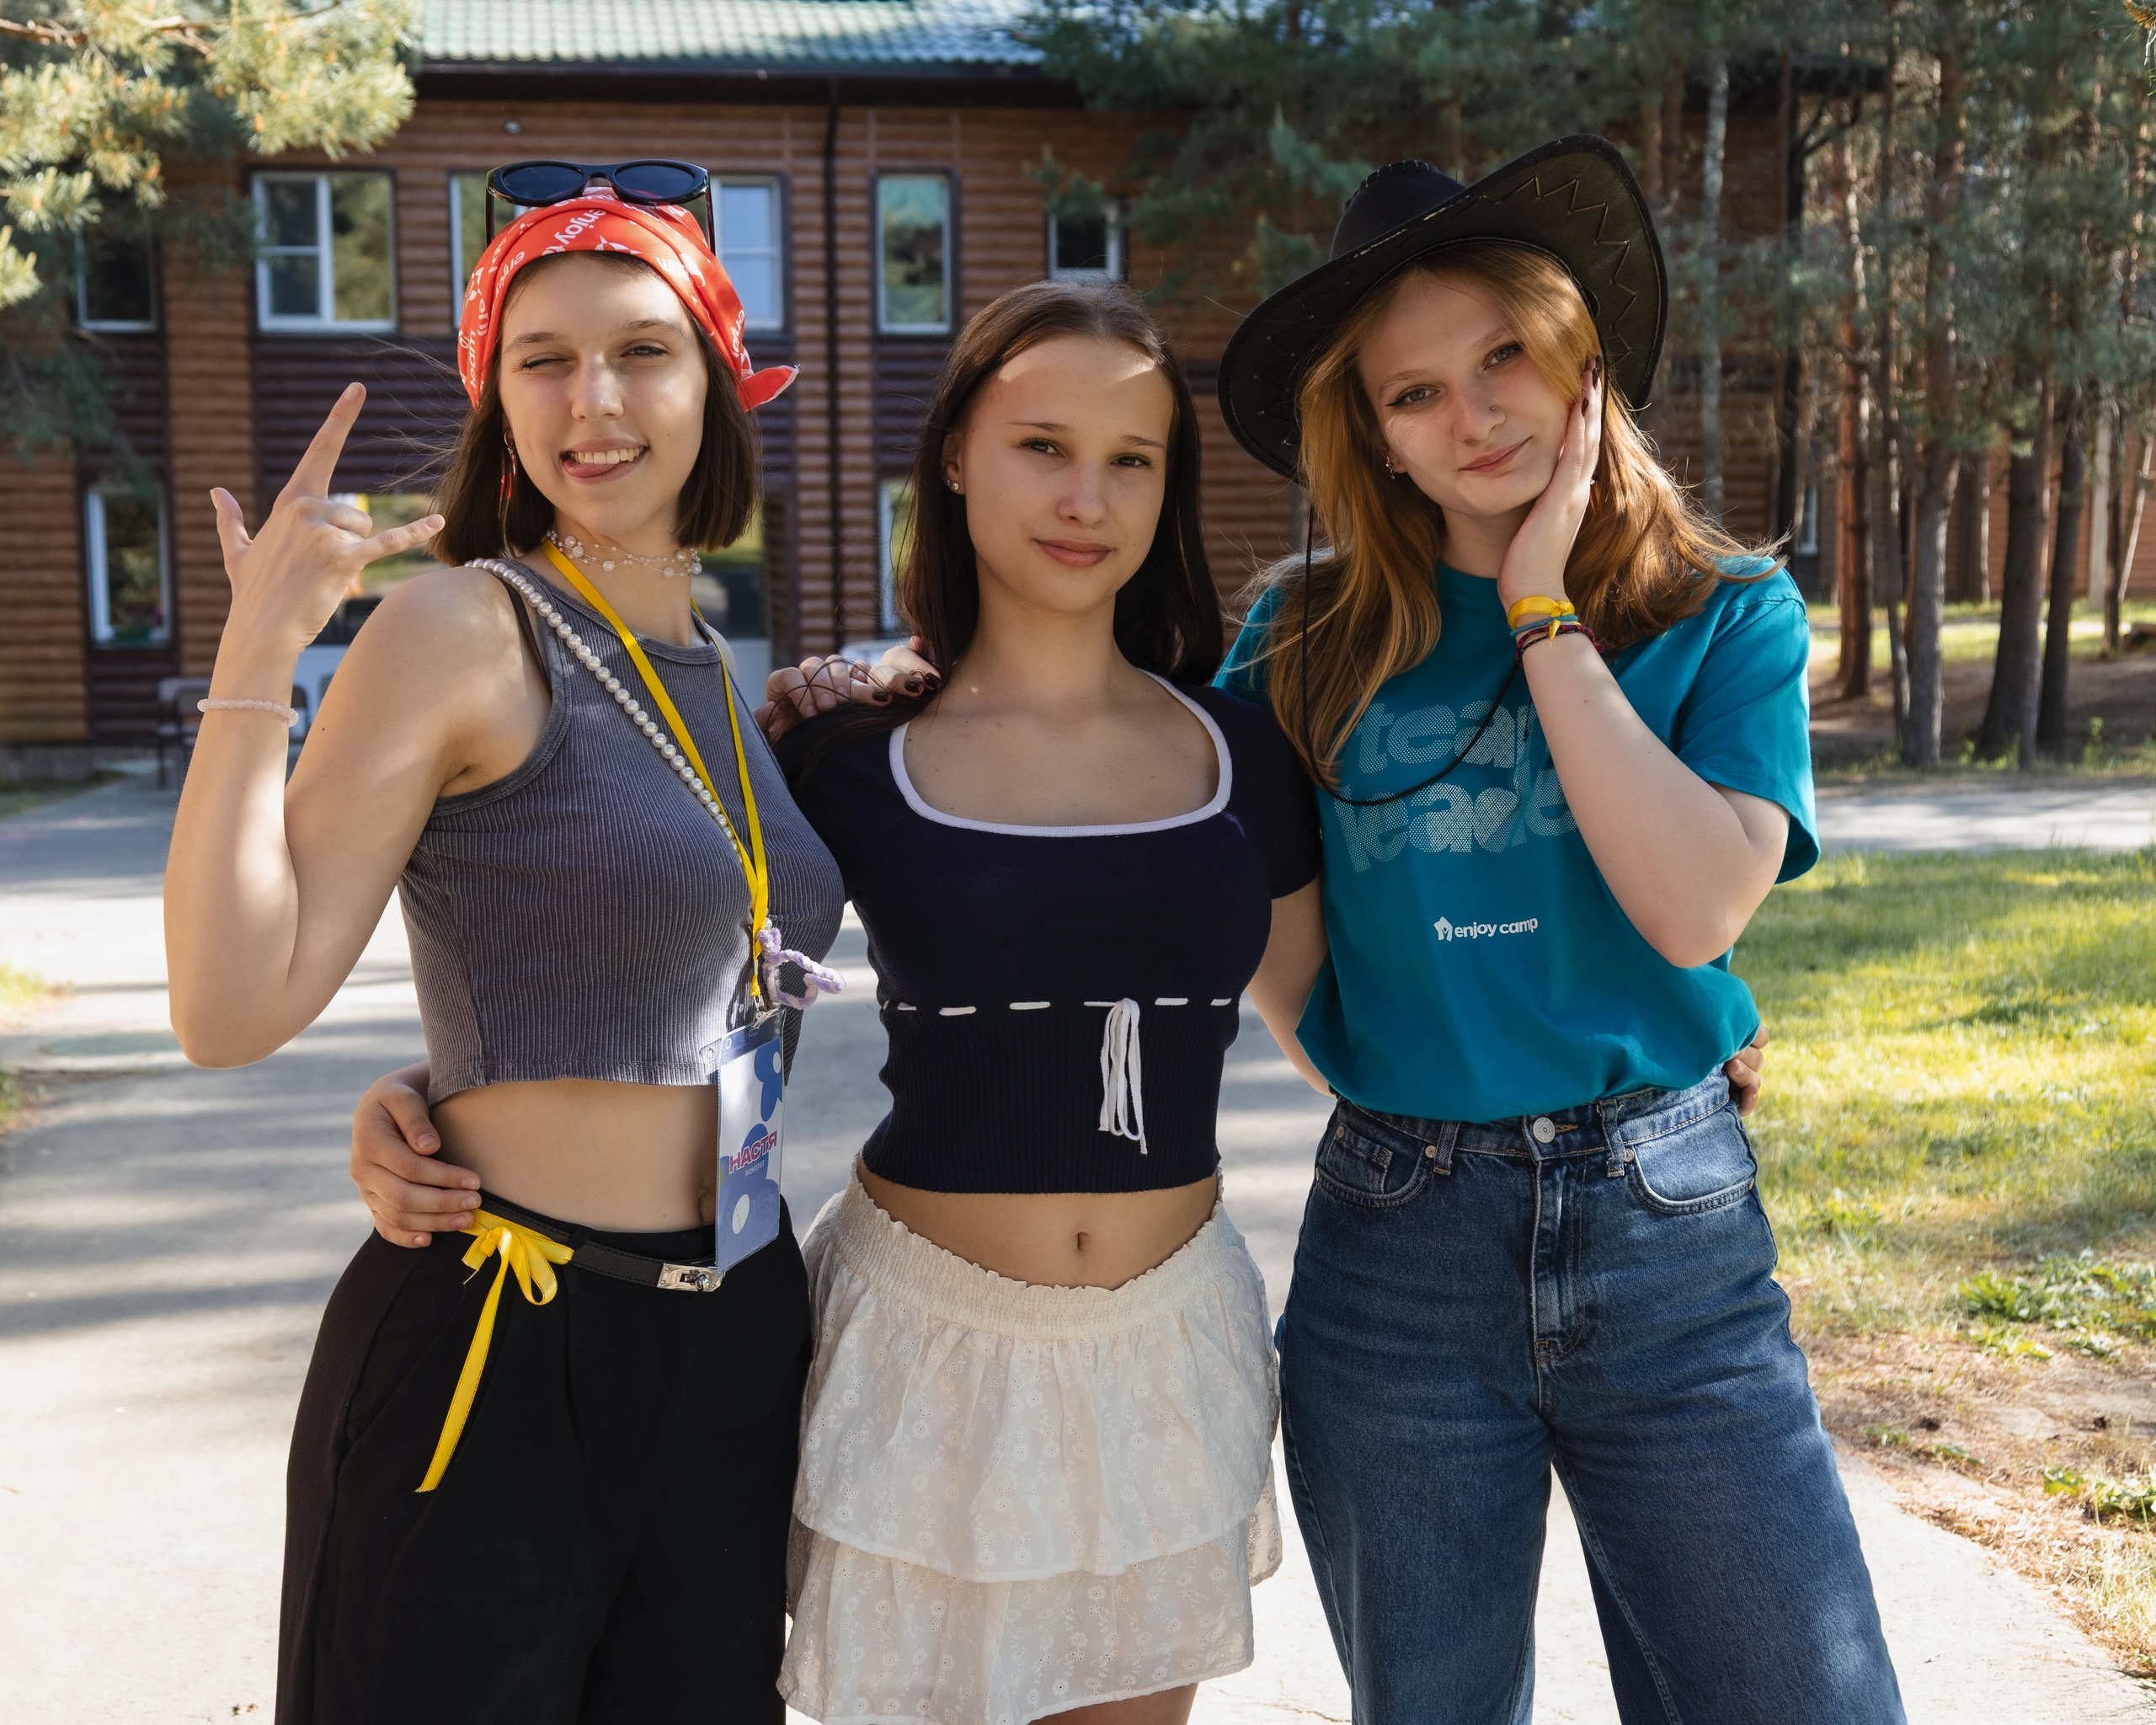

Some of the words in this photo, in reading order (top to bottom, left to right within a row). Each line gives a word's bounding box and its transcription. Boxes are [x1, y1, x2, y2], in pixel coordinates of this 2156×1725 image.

[553, 209, 606, 245] enjoy
[1333, 760, 1577, 874] leade
[1454, 921, 1497, 939] enjoy
[1499, 917, 1539, 933] camp
[728, 1130, 777, 1175] НАСТЯ
